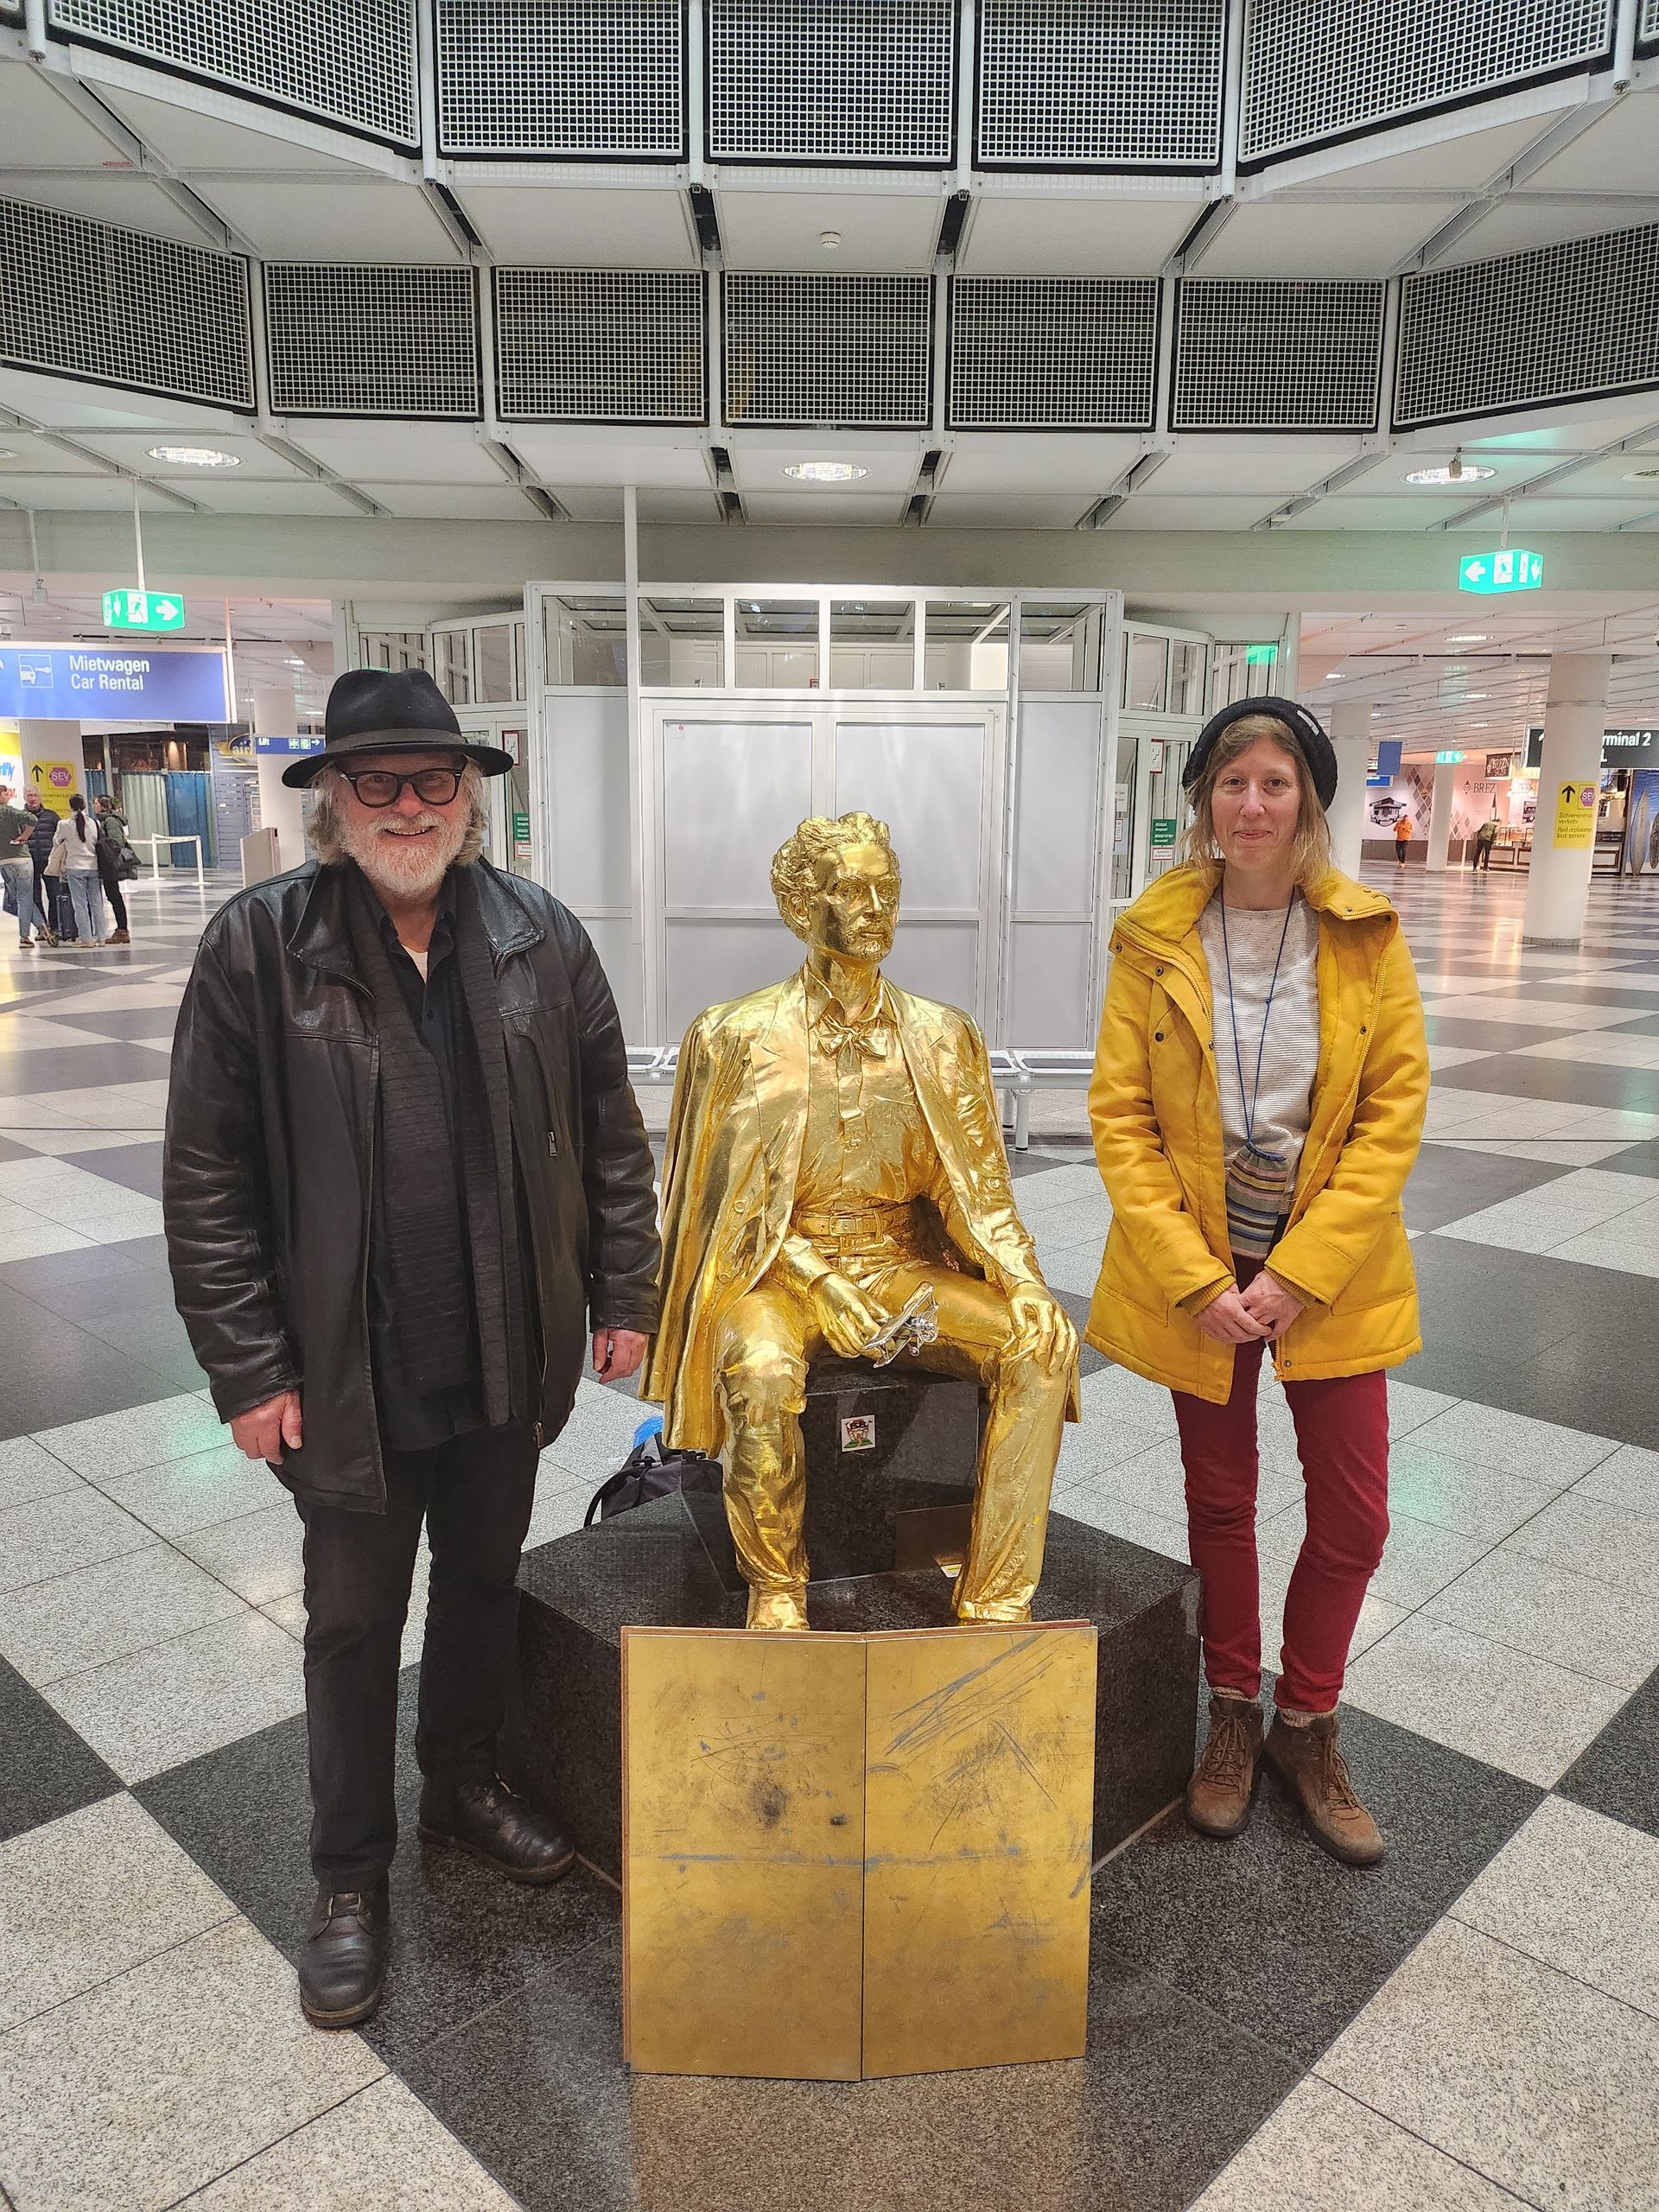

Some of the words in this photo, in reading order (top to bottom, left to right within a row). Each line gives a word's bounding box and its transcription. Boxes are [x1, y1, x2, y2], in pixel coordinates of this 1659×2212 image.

[69, 655, 150, 675] Mietwagen
[71, 675, 95, 690] Car
[99, 674, 144, 690] Rental
[1603, 732, 1640, 747] rminal
[1642, 732, 1652, 747] 2
[52, 772, 69, 781] SEV
